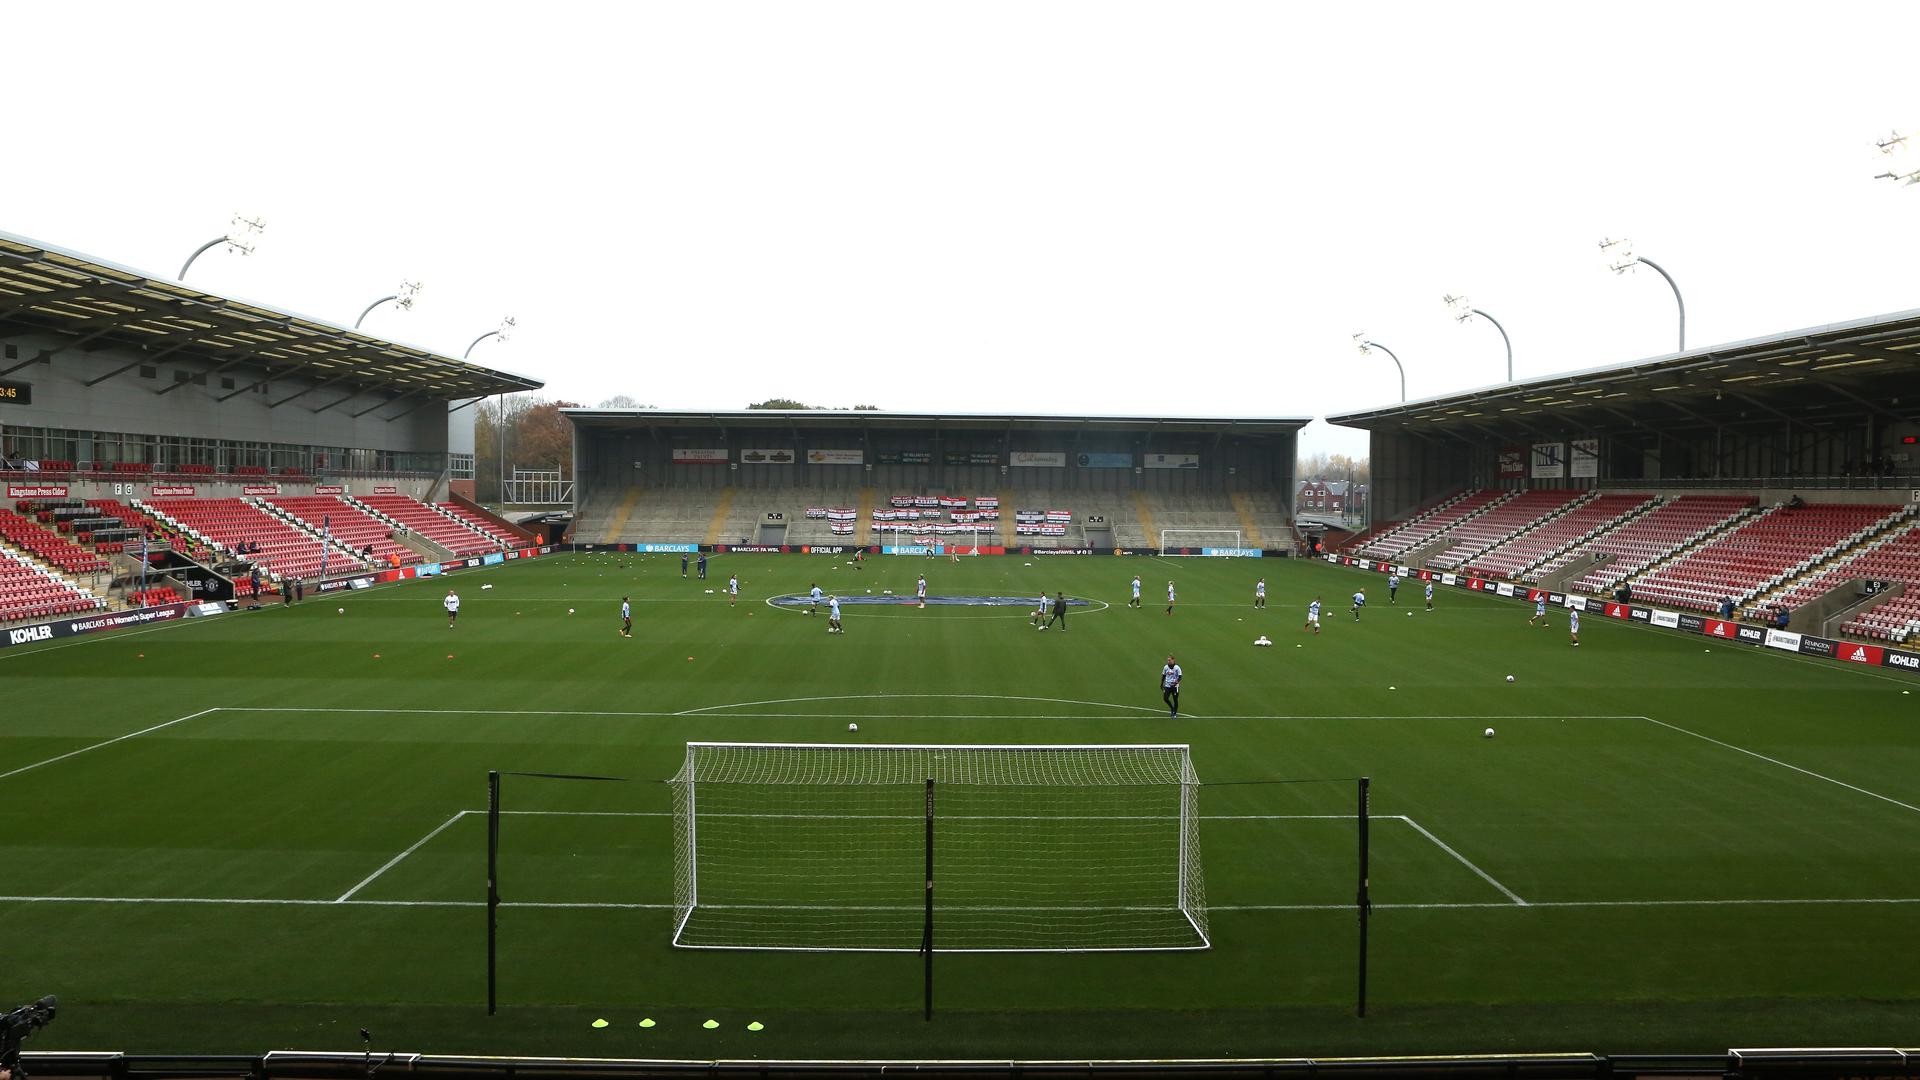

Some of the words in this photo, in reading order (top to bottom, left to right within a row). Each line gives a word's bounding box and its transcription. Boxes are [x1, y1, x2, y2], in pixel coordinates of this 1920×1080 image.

[10, 488, 37, 498] Kingstone
[37, 488, 52, 496] Press
[52, 487, 66, 496] Cider
[654, 545, 690, 553] BARCLAYS
[810, 546, 832, 554] OFFICIAL
[832, 546, 843, 554] APP
[78, 620, 105, 631] BARCLAYS
[106, 618, 115, 626] FA
[114, 614, 139, 625] Women's
[139, 611, 156, 620] Super
[155, 609, 176, 618] League
[9, 625, 53, 645] KOHLER
[1739, 628, 1761, 640] KOHLER
[1803, 639, 1830, 649] REMINGTON
[1889, 653, 1920, 668] KOHLER
